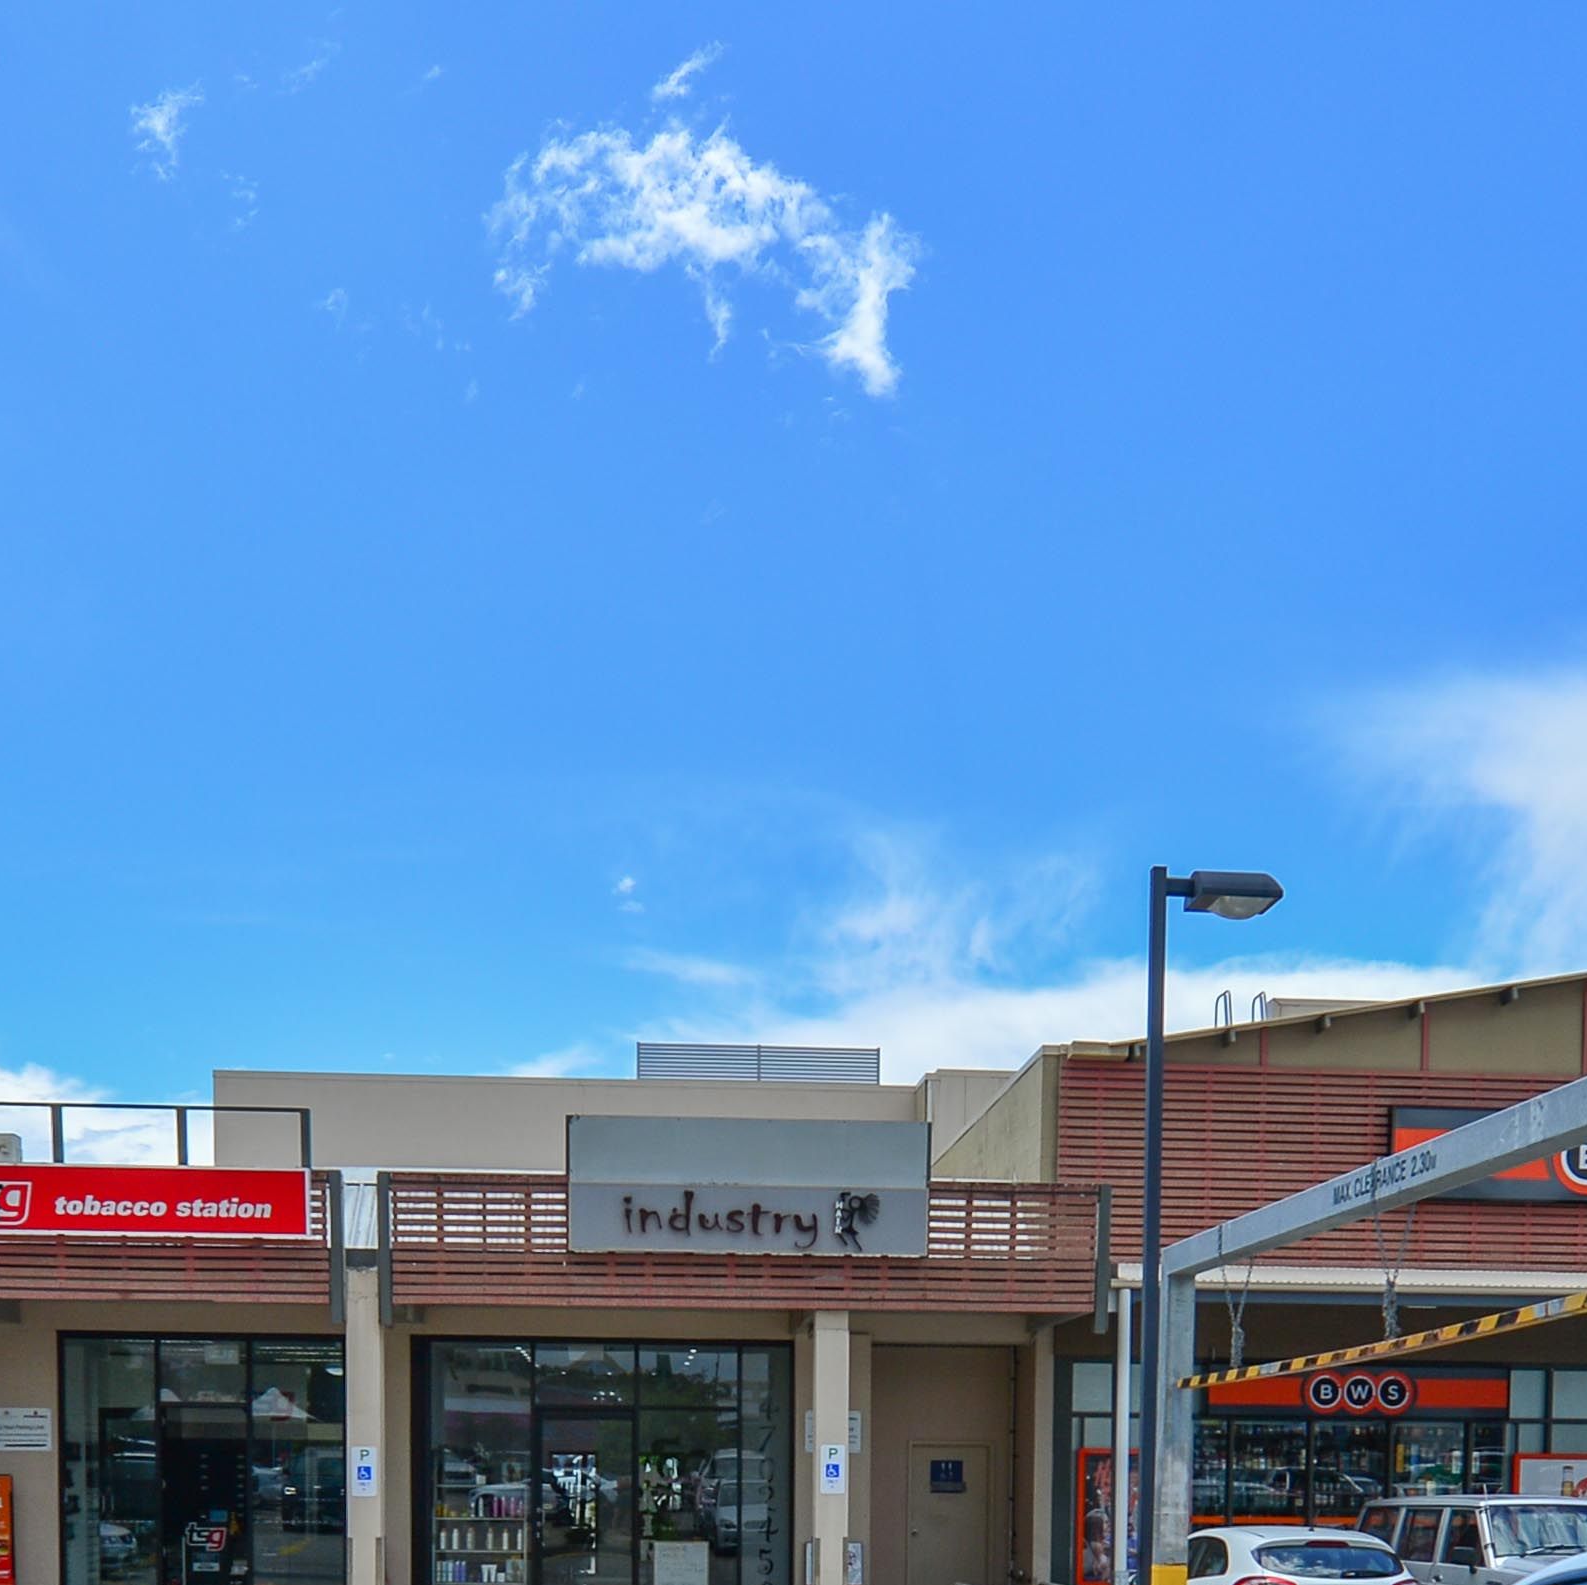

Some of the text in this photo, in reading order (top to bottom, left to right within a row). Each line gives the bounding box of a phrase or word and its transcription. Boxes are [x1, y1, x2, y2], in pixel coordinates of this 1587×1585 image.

[54, 1194, 272, 1220] tobacco station
[622, 1190, 818, 1249] industry
[834, 1200, 844, 1234] HAIR
[1320, 1384, 1399, 1400] BWS
[360, 1449, 370, 1461] P
[828, 1447, 838, 1459] P
[184, 1521, 227, 1552] tsg
